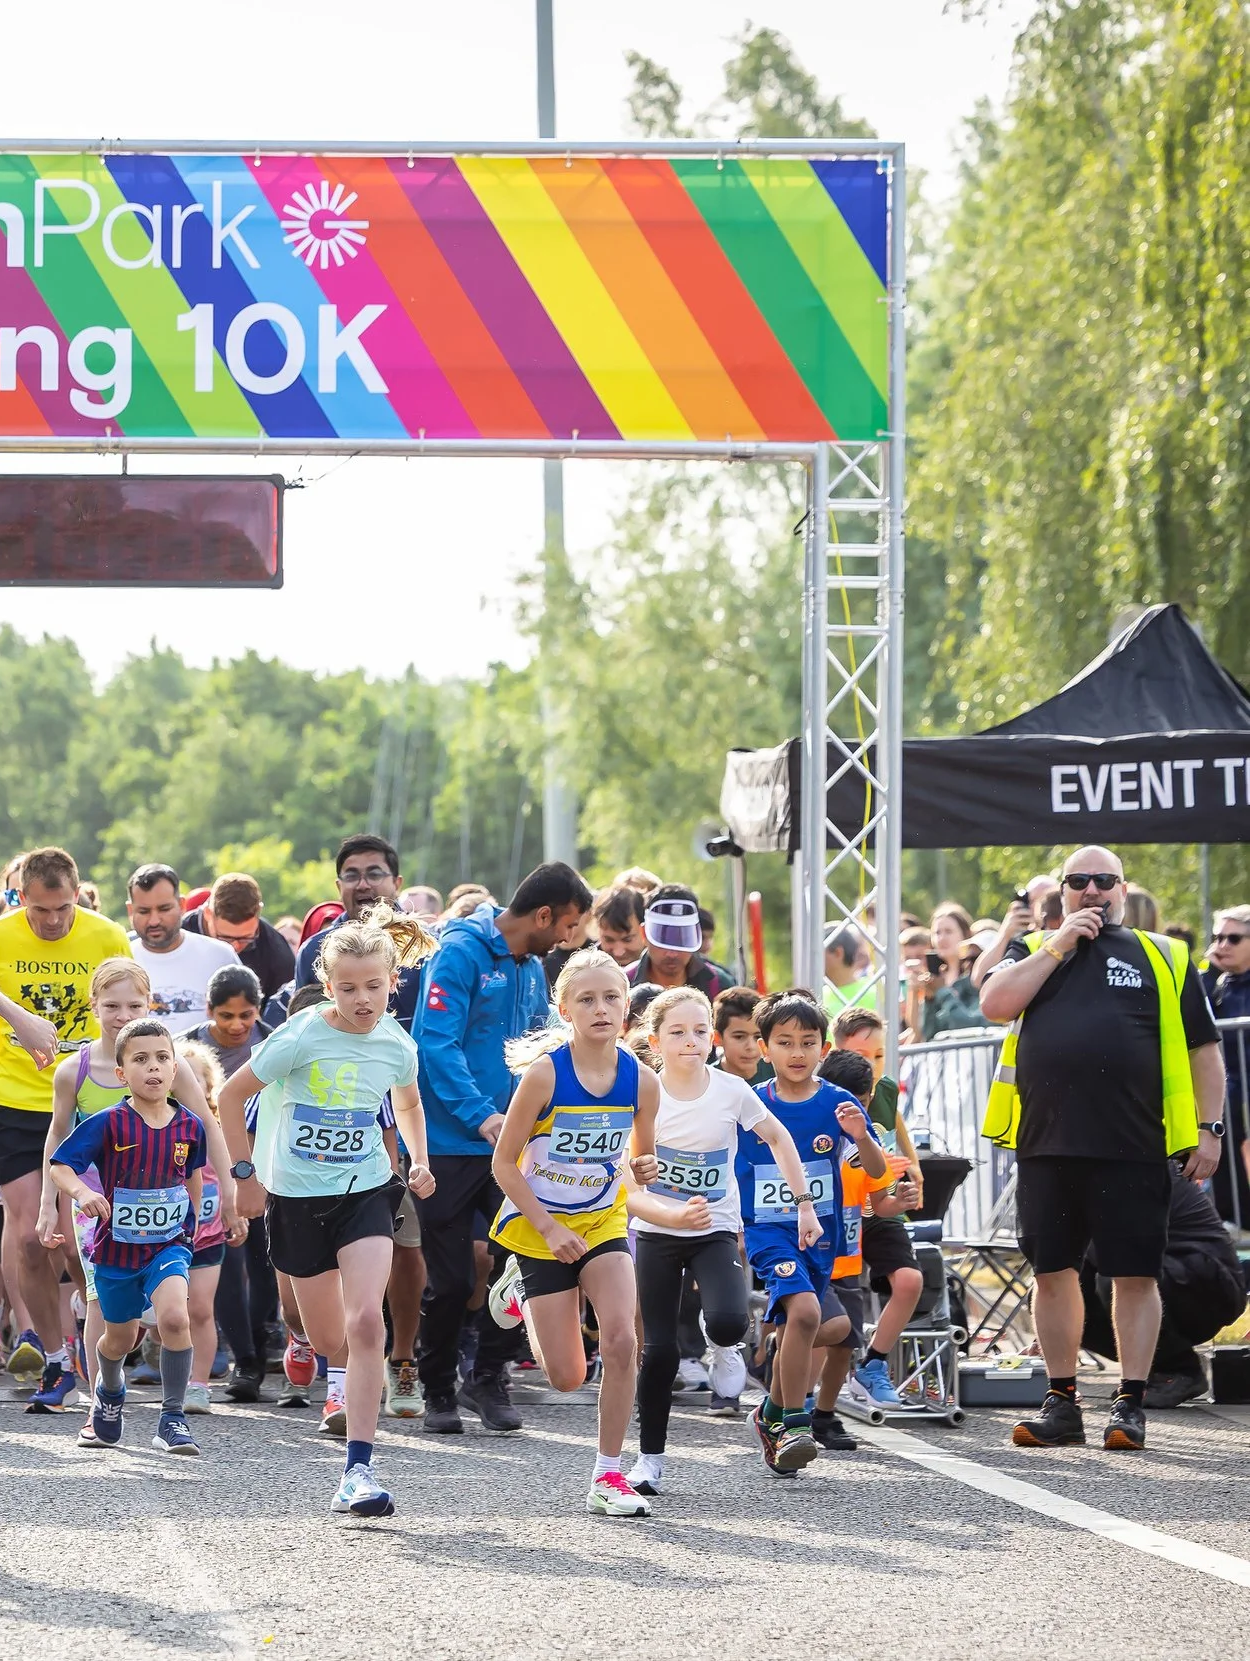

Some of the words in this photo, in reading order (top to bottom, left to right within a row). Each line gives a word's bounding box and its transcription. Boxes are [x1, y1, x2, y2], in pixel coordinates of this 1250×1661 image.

[177, 302, 390, 395] 10K
[1051, 759, 1204, 812] EVENT
[1213, 758, 1250, 806] T
[15, 960, 90, 975] BOSTON
[1107, 975, 1142, 988] TEAM
[295, 1125, 365, 1152] 2528
[555, 1131, 623, 1154] 2540
[531, 1161, 576, 1186] Team
[657, 1160, 720, 1188] 2530
[762, 1179, 824, 1204] 260
[118, 1204, 182, 1227] 2604
